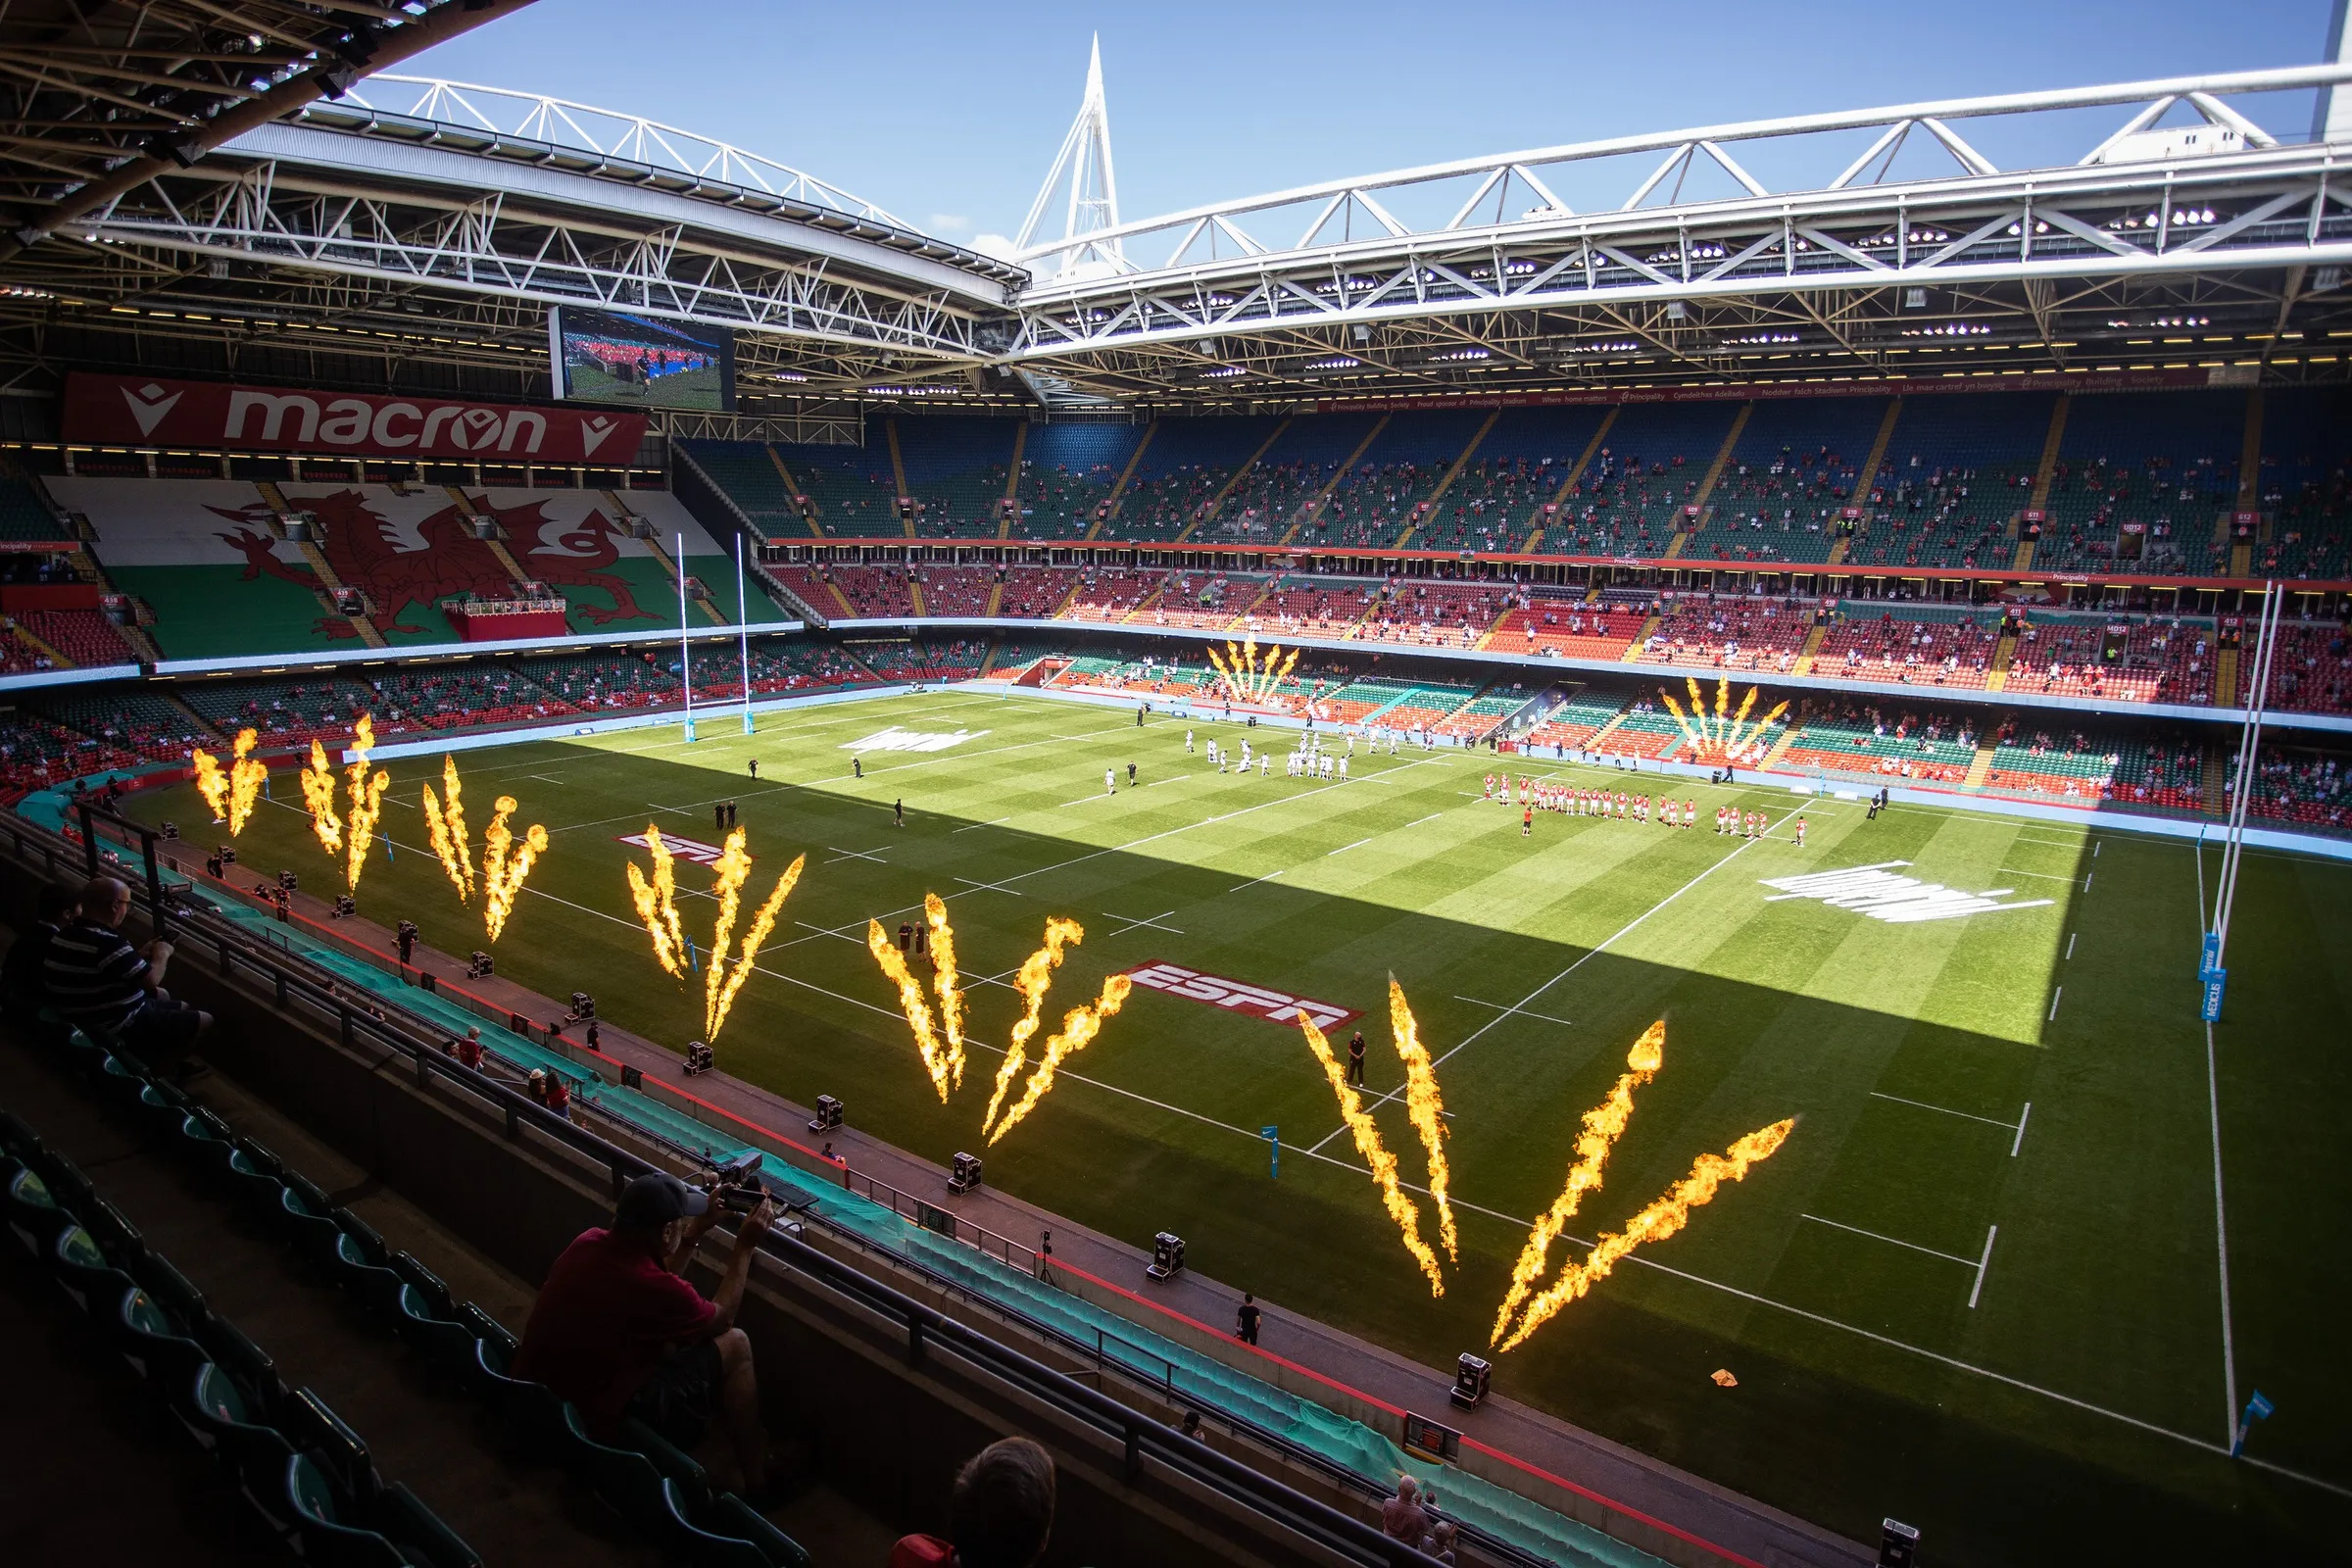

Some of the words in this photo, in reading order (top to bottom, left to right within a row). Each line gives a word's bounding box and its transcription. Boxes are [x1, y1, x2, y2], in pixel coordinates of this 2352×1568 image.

[1936, 382, 1963, 391] cartref
[1964, 383, 1976, 392] yn
[1977, 381, 2006, 390] bwysig
[2033, 378, 2082, 388] Principality
[2085, 377, 2123, 386] Building
[2131, 375, 2164, 385] Society
[1814, 386, 1847, 395] Stadiwm
[1849, 385, 1892, 395] Principality
[1470, 398, 1500, 407] Principality
[1630, 393, 1665, 402] Principality
[1366, 402, 1388, 411] Building
[223, 390, 547, 453] macron
[1127, 963, 1349, 1028] ESPN
[2206, 983, 2221, 1017] MEDICUS
